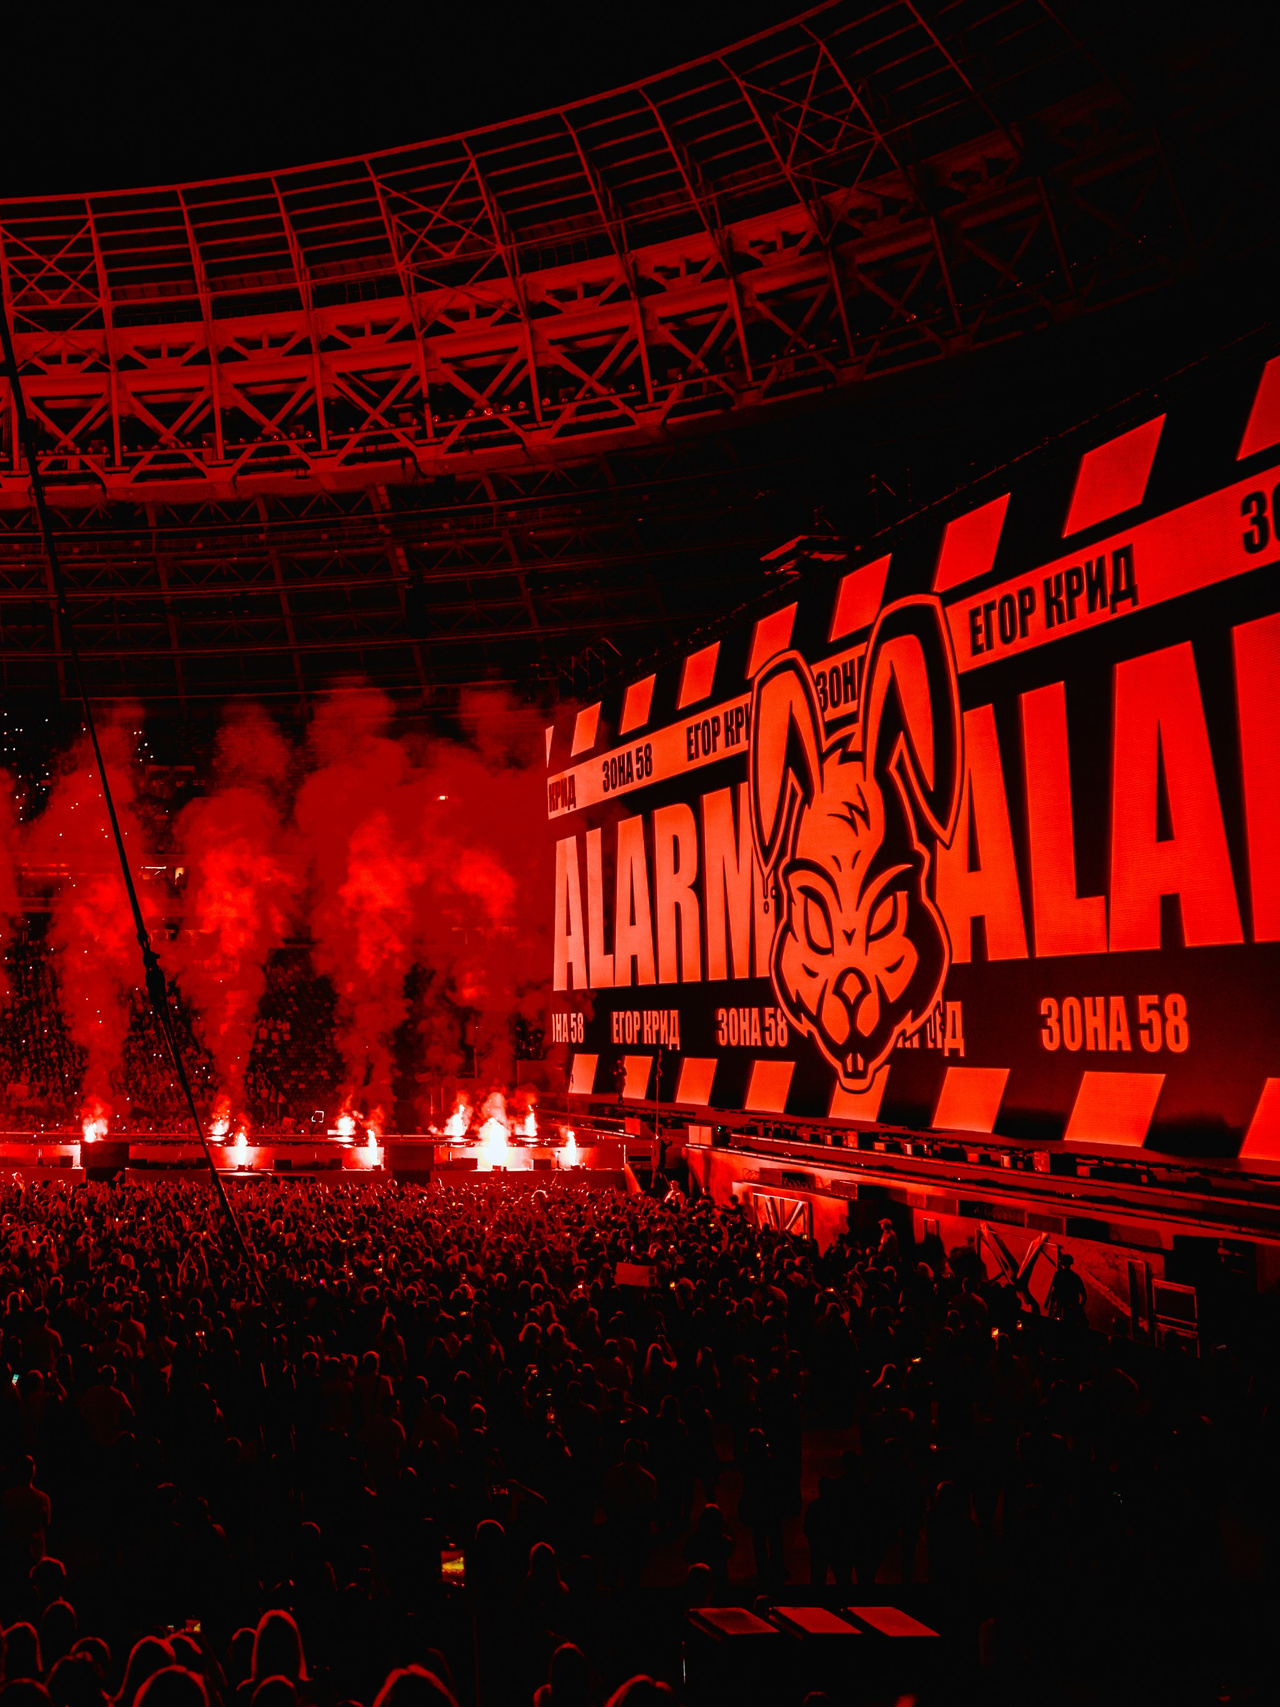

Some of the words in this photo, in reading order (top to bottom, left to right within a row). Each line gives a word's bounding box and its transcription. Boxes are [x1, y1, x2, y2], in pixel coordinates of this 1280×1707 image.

[969, 585, 1036, 657] ЕГОР
[1043, 543, 1139, 630] КРИД
[816, 656, 862, 713] ЗОН
[686, 715, 721, 763] ЕГОР
[602, 750, 634, 793] ЗОНА
[636, 742, 654, 780] 58
[549, 773, 577, 812] КРИД
[553, 781, 776, 991] ALARM
[570, 1012, 584, 1043] 58
[612, 1010, 641, 1044] ЕГОР
[643, 1009, 680, 1050] КРИД
[718, 1007, 762, 1047] ЗОНА
[765, 1006, 789, 1047] 58
[1040, 995, 1132, 1052] ЗОНА
[1138, 993, 1190, 1053] 58
